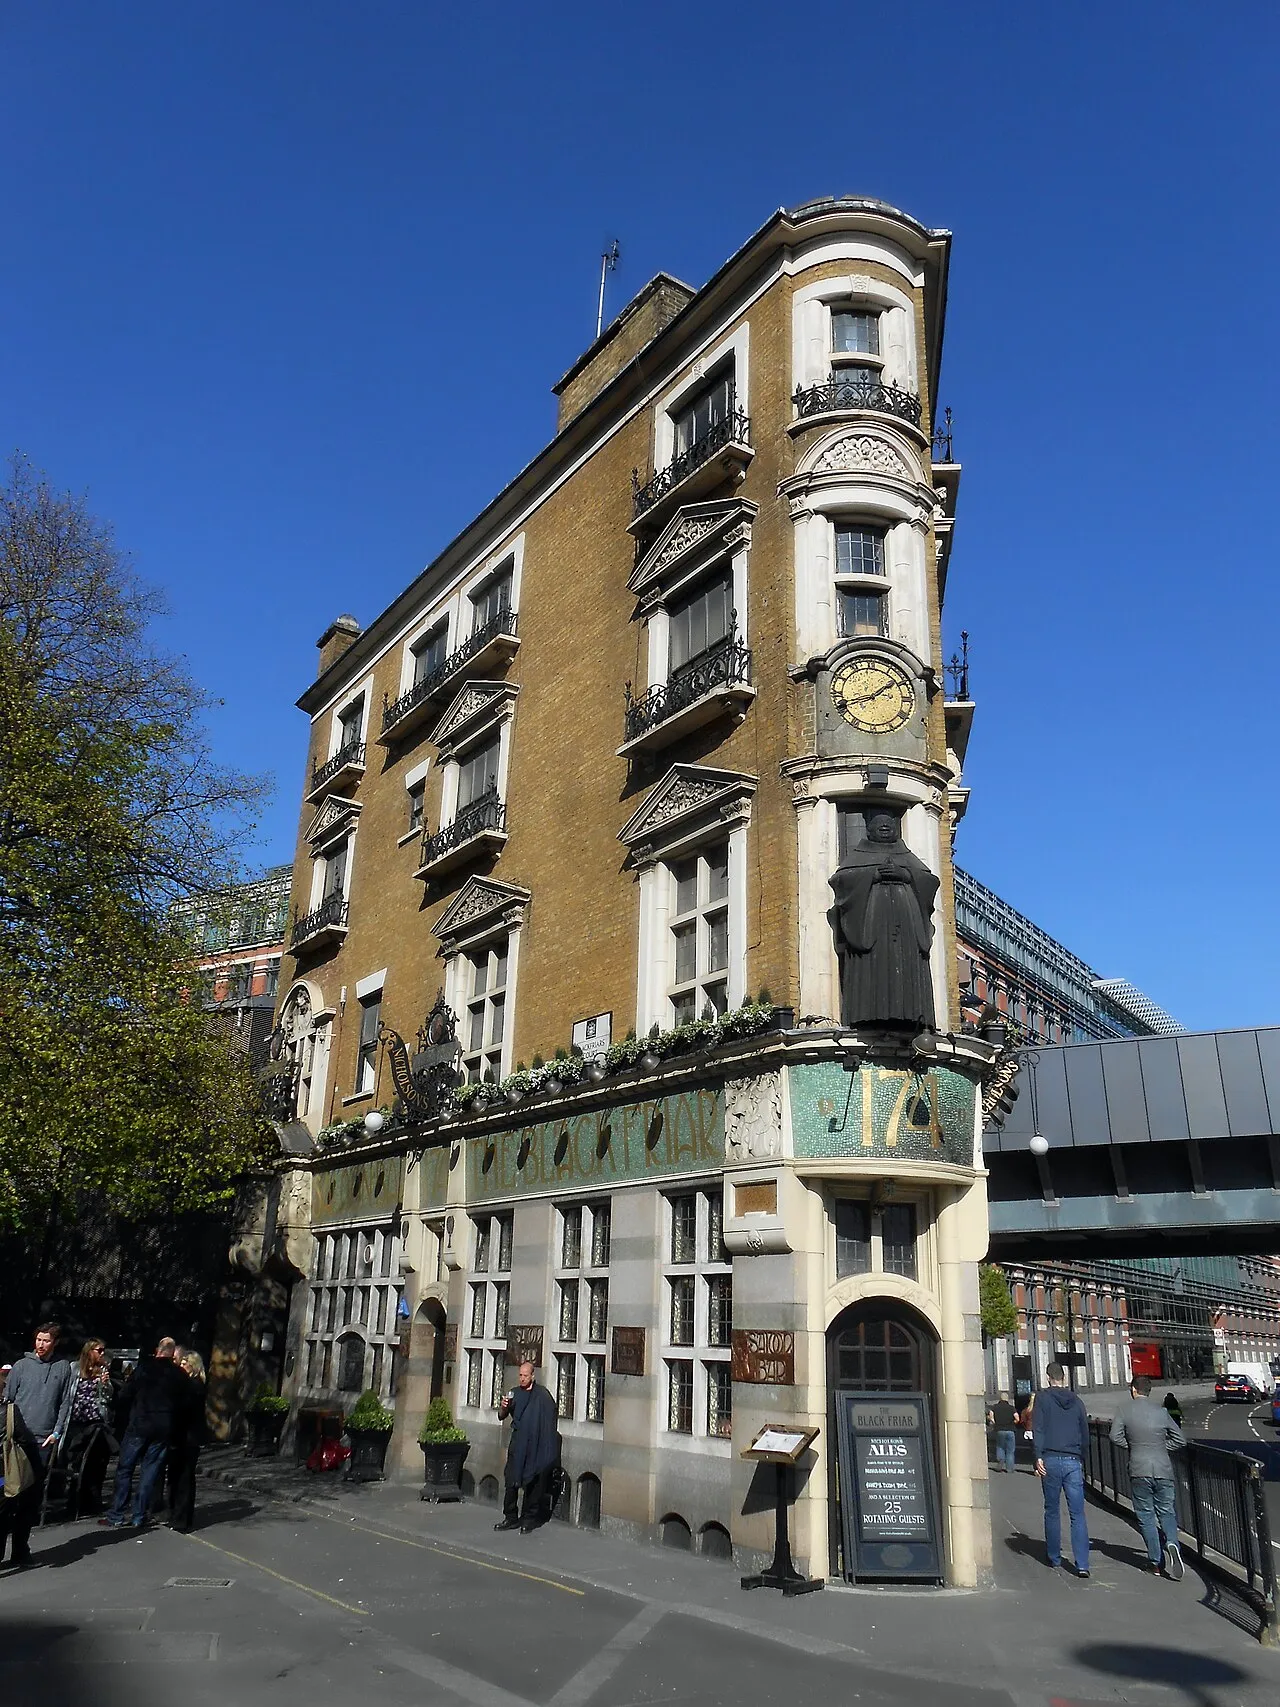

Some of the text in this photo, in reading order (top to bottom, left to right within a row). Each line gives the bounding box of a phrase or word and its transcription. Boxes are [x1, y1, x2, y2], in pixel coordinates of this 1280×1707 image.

[522, 1110, 617, 1185] BLACK
[623, 1089, 721, 1171] FRIAR
[757, 1359, 787, 1381] BAR
[857, 1415, 913, 1426] BLACK FRIAR
[868, 1444, 908, 1457] ALES
[884, 1501, 902, 1514] 25
[863, 1514, 925, 1524] ROTATING GUESTS
